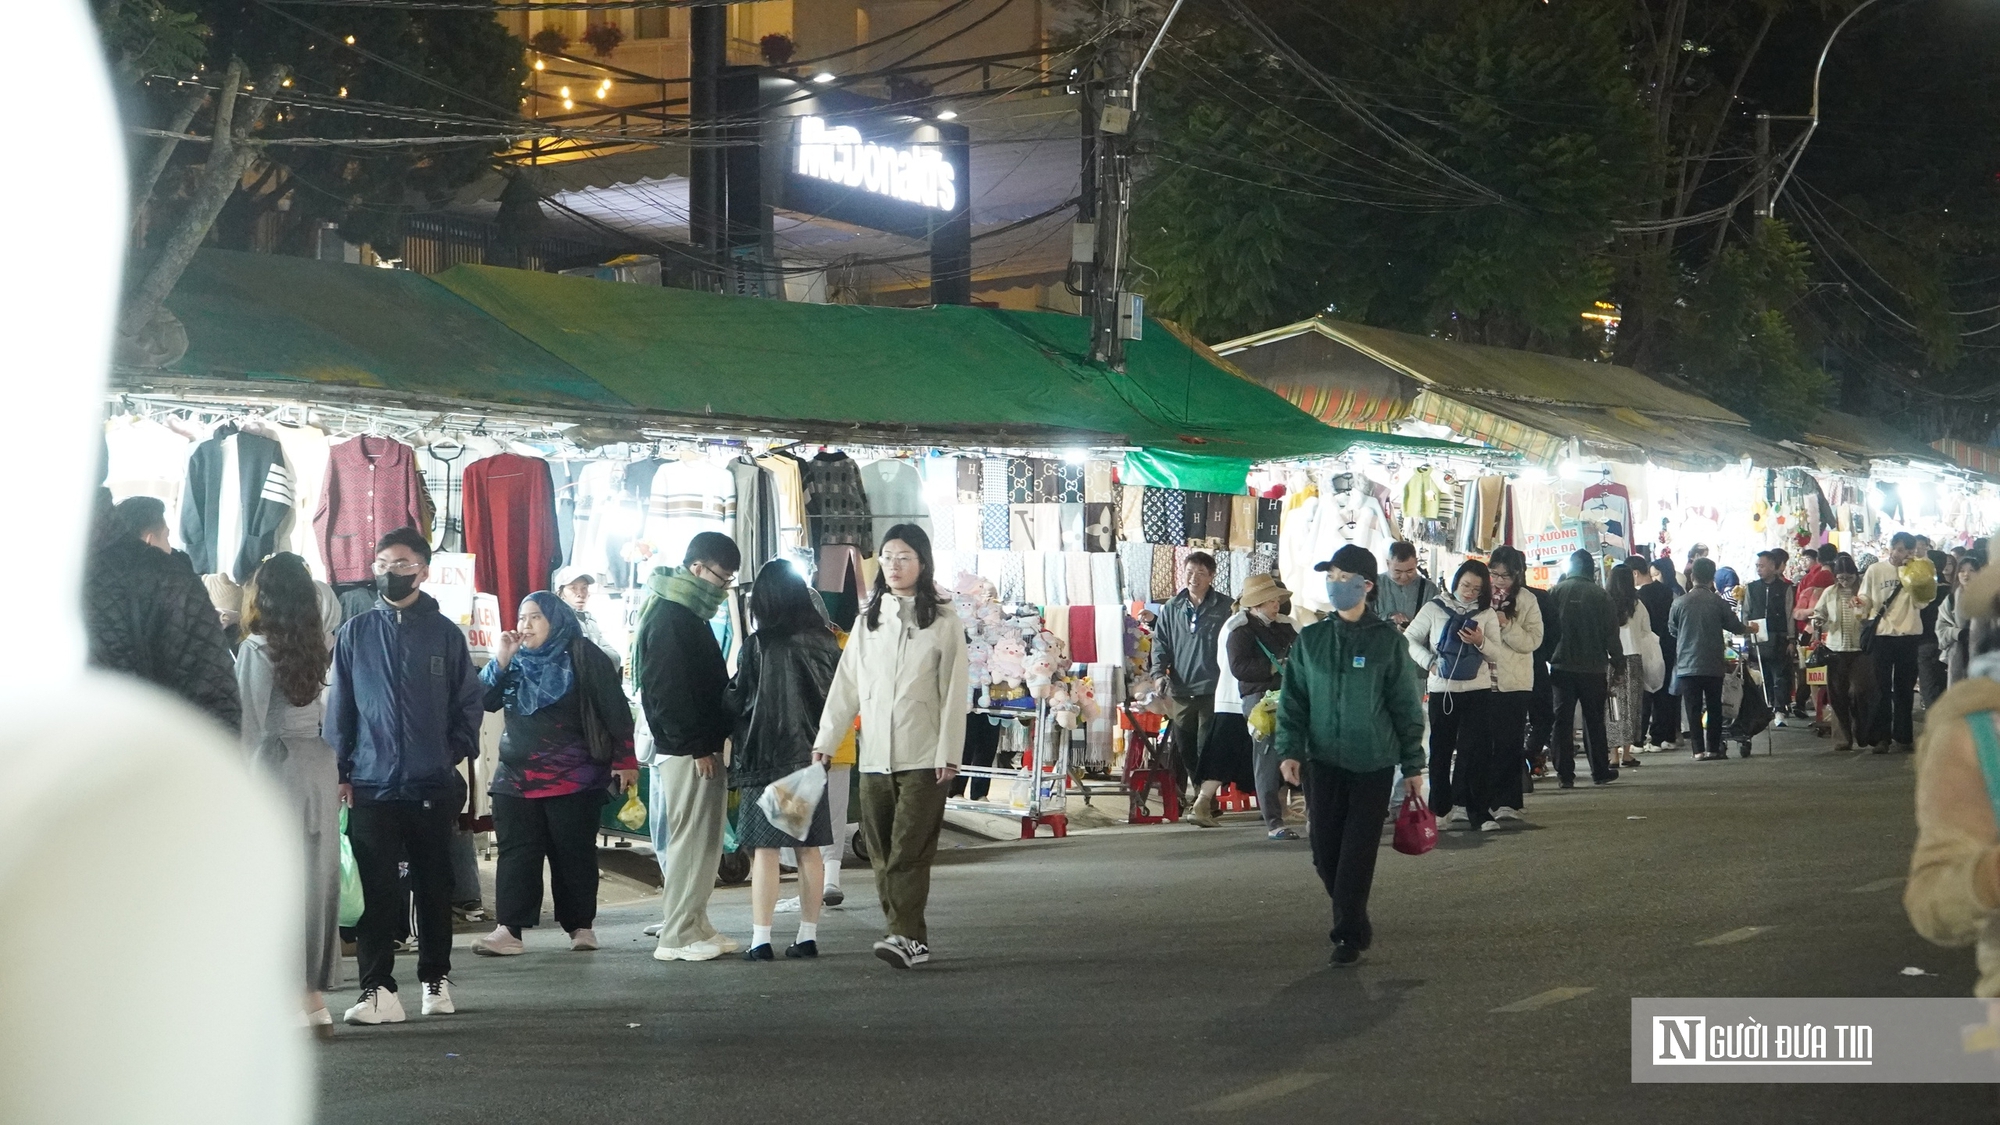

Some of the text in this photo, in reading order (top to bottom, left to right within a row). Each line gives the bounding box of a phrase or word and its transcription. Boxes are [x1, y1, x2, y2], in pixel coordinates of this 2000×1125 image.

[799, 115, 956, 212] McDonald's
[427, 566, 468, 586] LEN
[1533, 566, 1549, 581] 30
[468, 629, 494, 648] 90K
